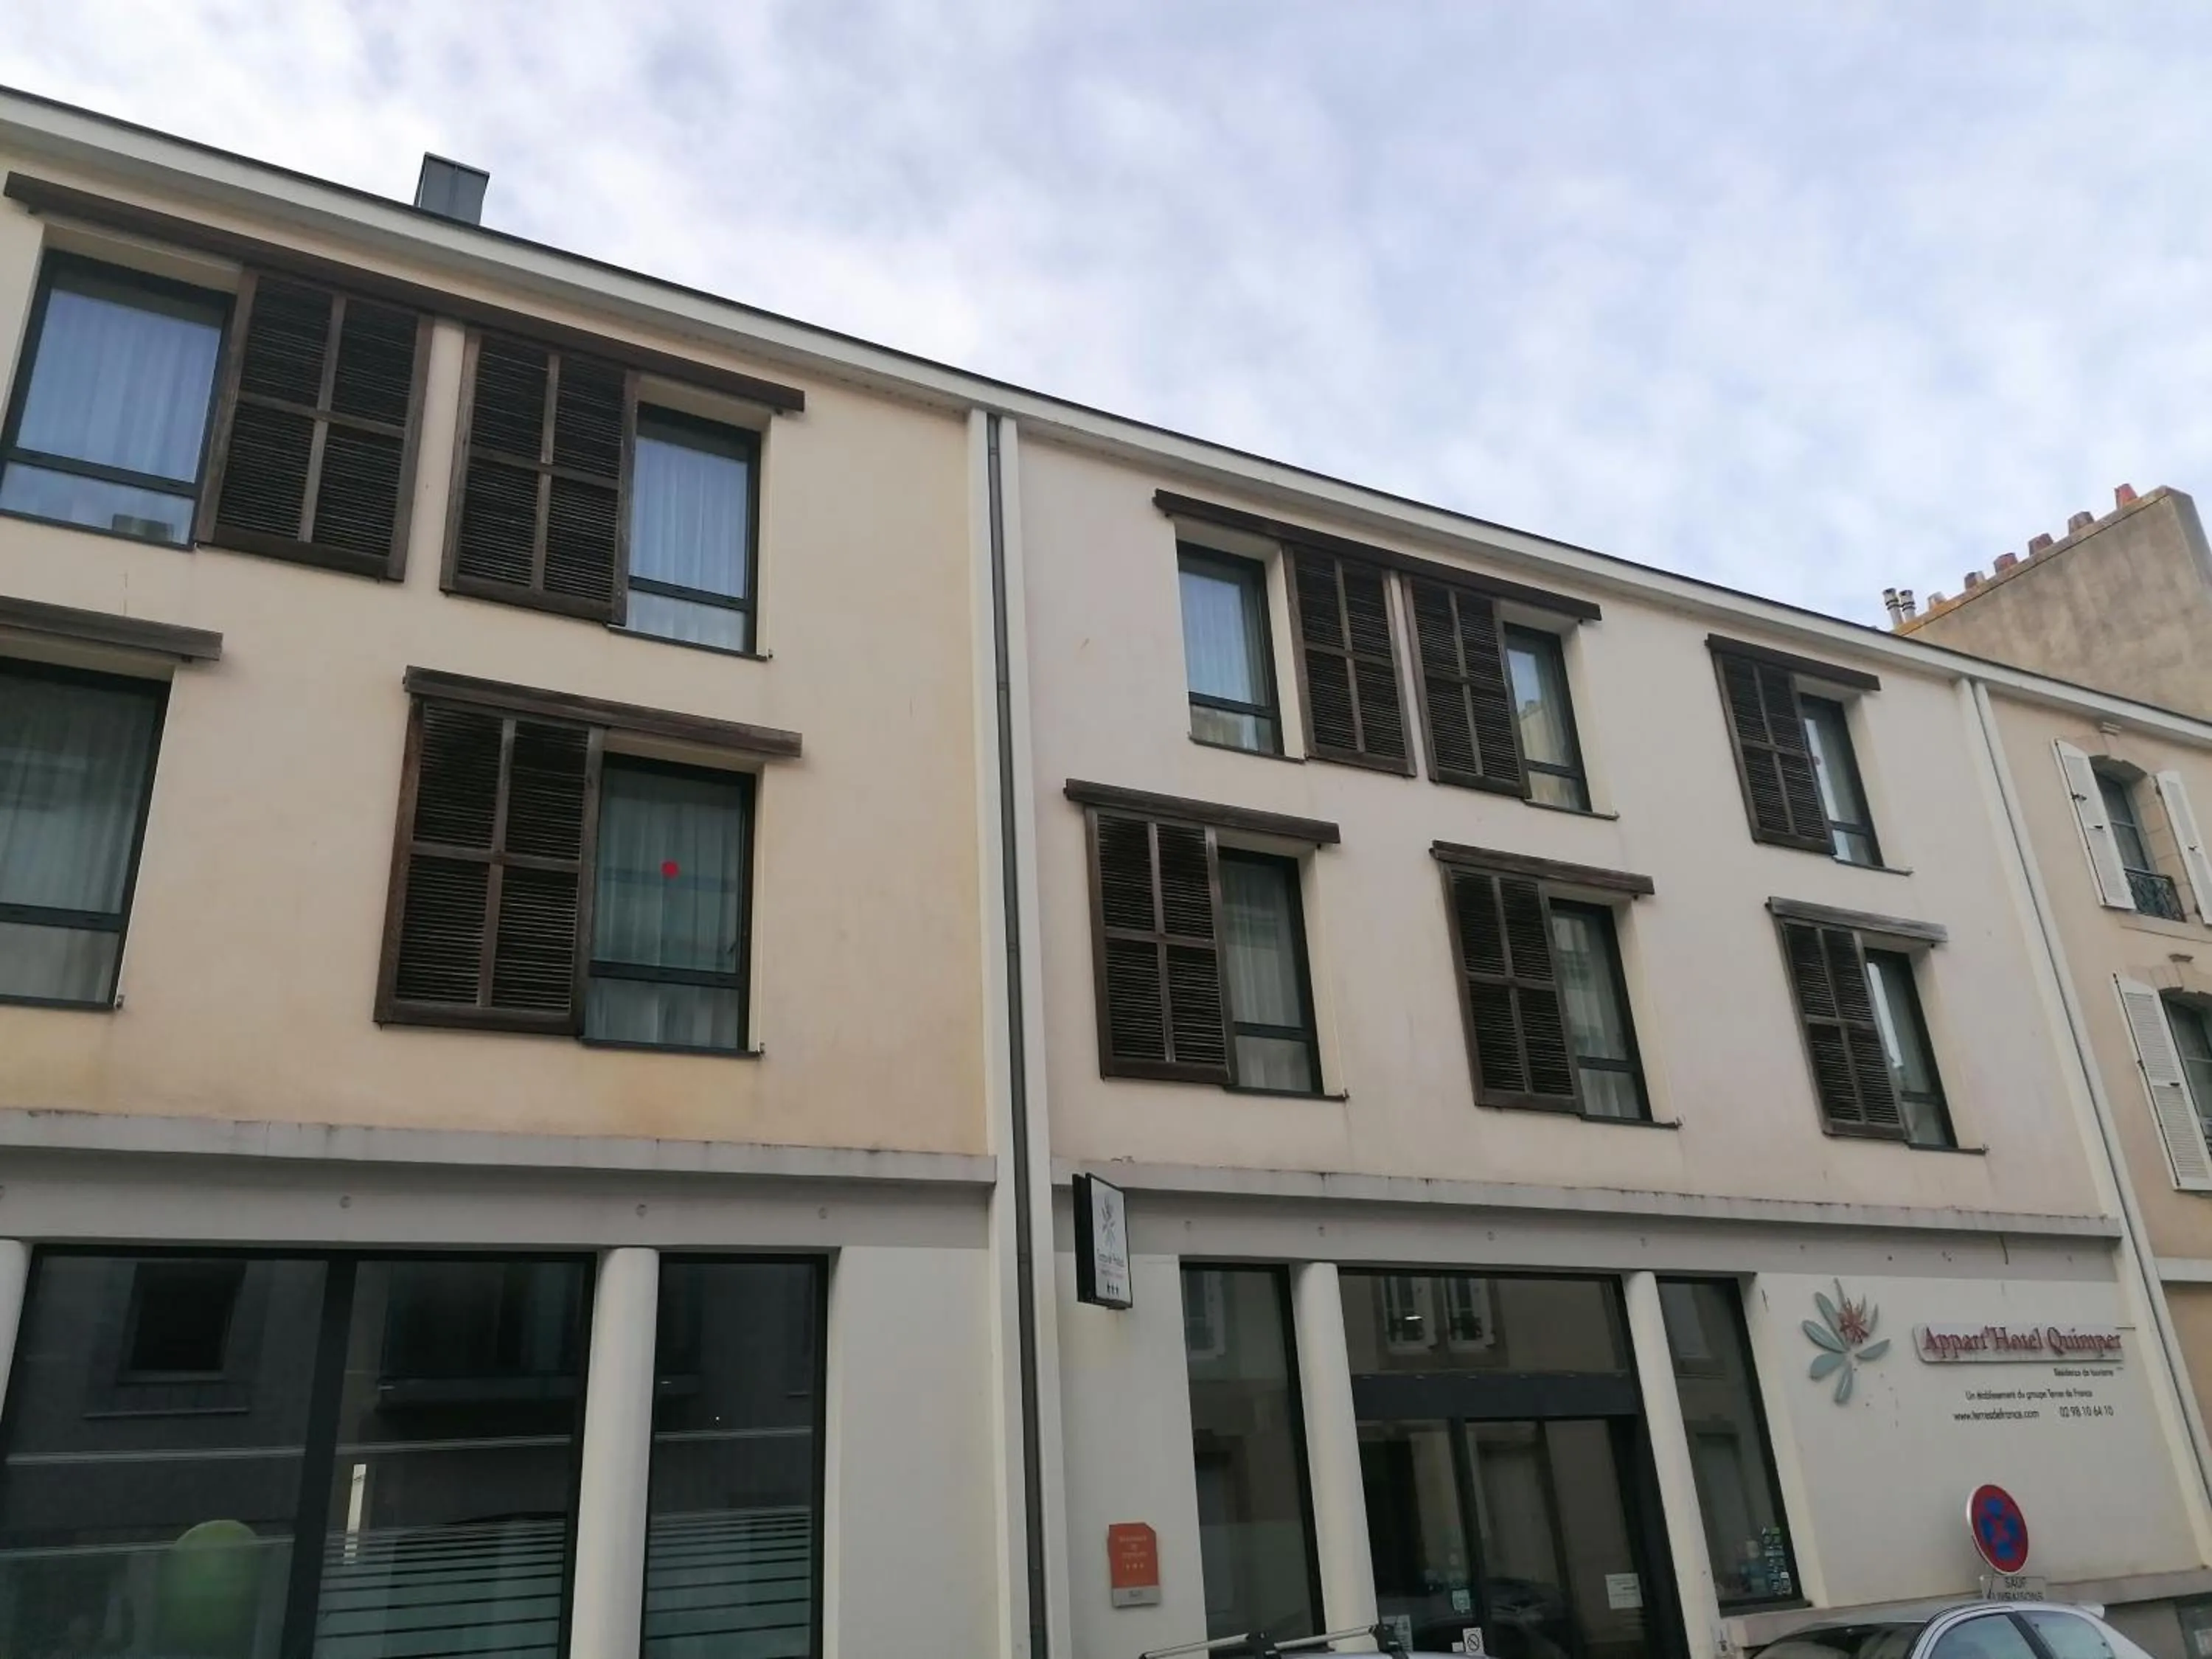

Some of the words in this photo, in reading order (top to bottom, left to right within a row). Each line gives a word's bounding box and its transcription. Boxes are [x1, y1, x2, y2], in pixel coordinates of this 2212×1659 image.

[2047, 1326, 2122, 1357] Quimper
[1965, 1391, 1975, 1400] Un
[2017, 1389, 2025, 1399] du
[2059, 1405, 2069, 1417] 02
[2070, 1405, 2081, 1417] 98
[2081, 1405, 2092, 1416] 10
[2093, 1405, 2103, 1416] 64
[2104, 1404, 2114, 1416] 10
[2005, 1576, 2027, 1588] SAUF
